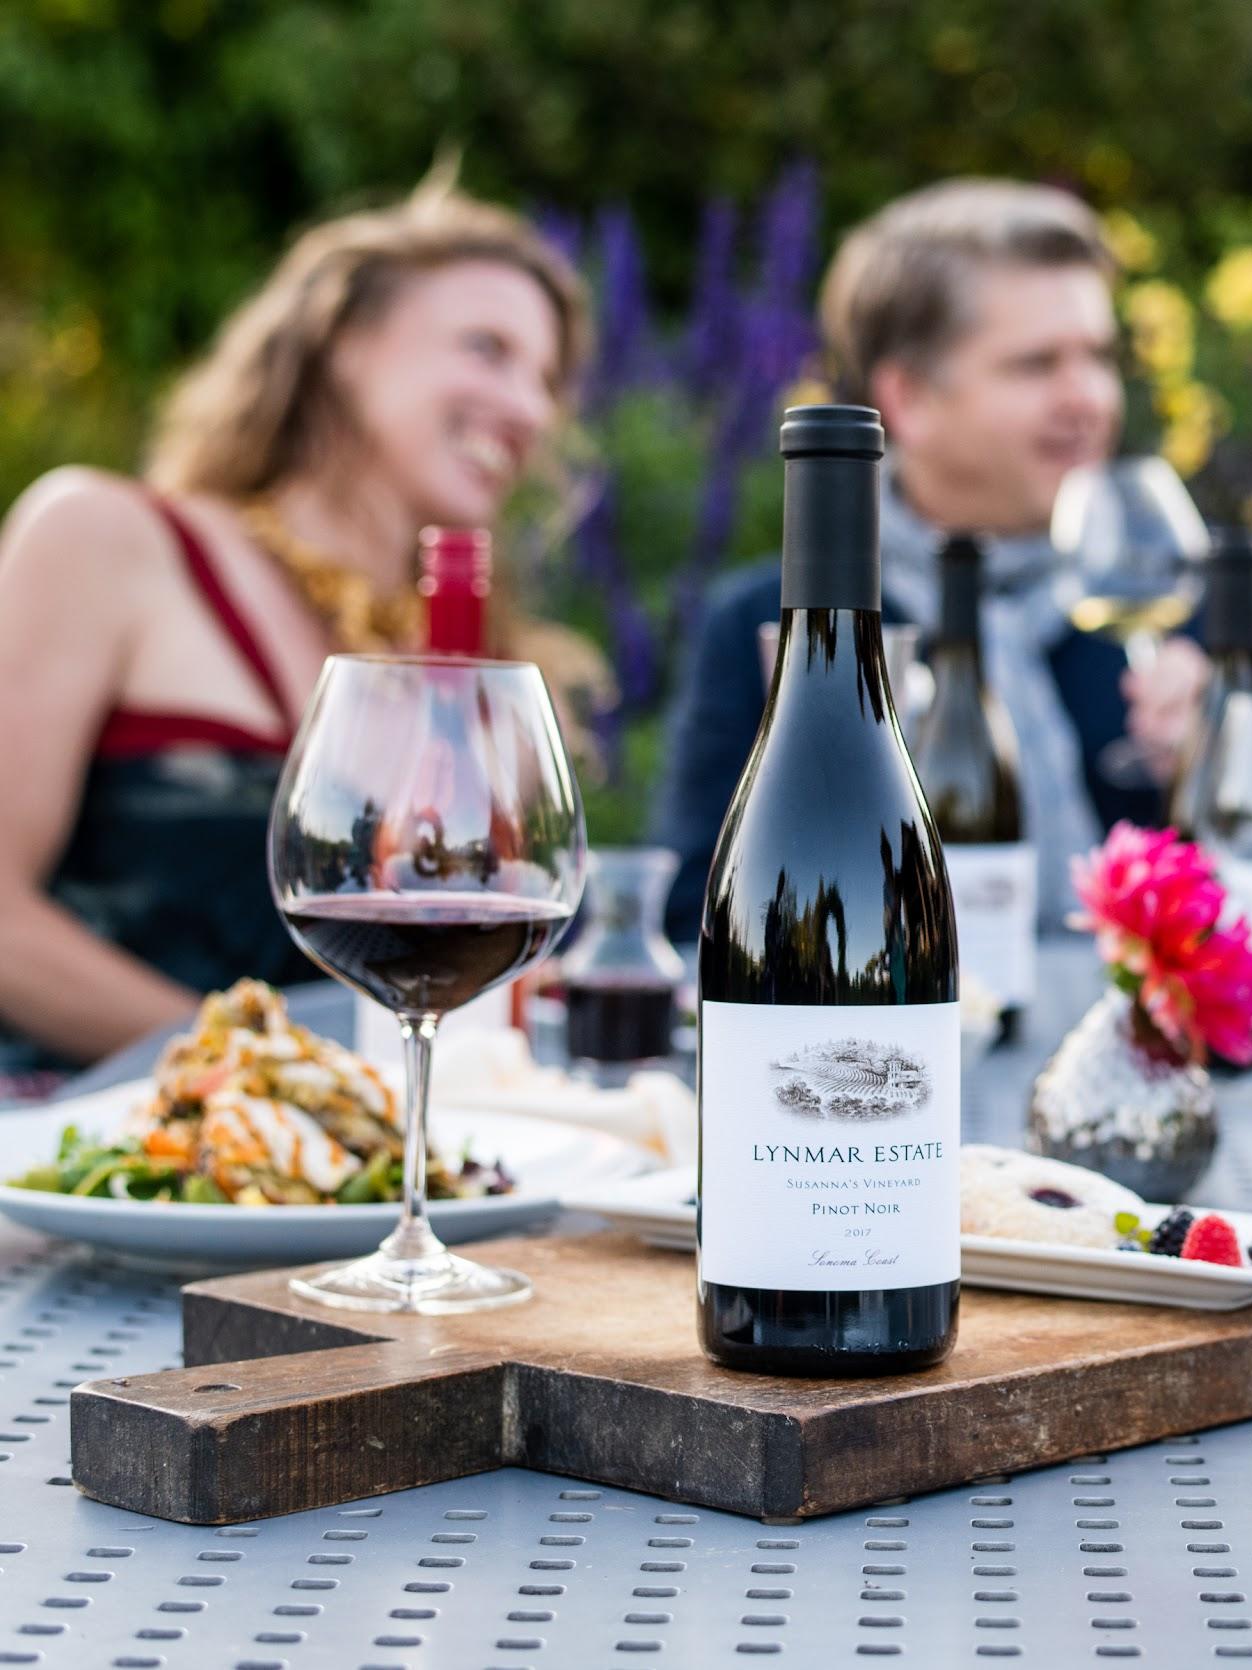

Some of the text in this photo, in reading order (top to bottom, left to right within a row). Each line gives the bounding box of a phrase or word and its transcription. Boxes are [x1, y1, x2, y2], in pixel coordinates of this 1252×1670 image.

[753, 1142, 943, 1163] LYNMAR ESTATE
[786, 1177, 921, 1190] SUSANNA'S VINEYARD
[812, 1202, 901, 1215] PINOT NOIR
[844, 1228, 872, 1238] 2017
[808, 1248, 900, 1267] Sonoma Coast
